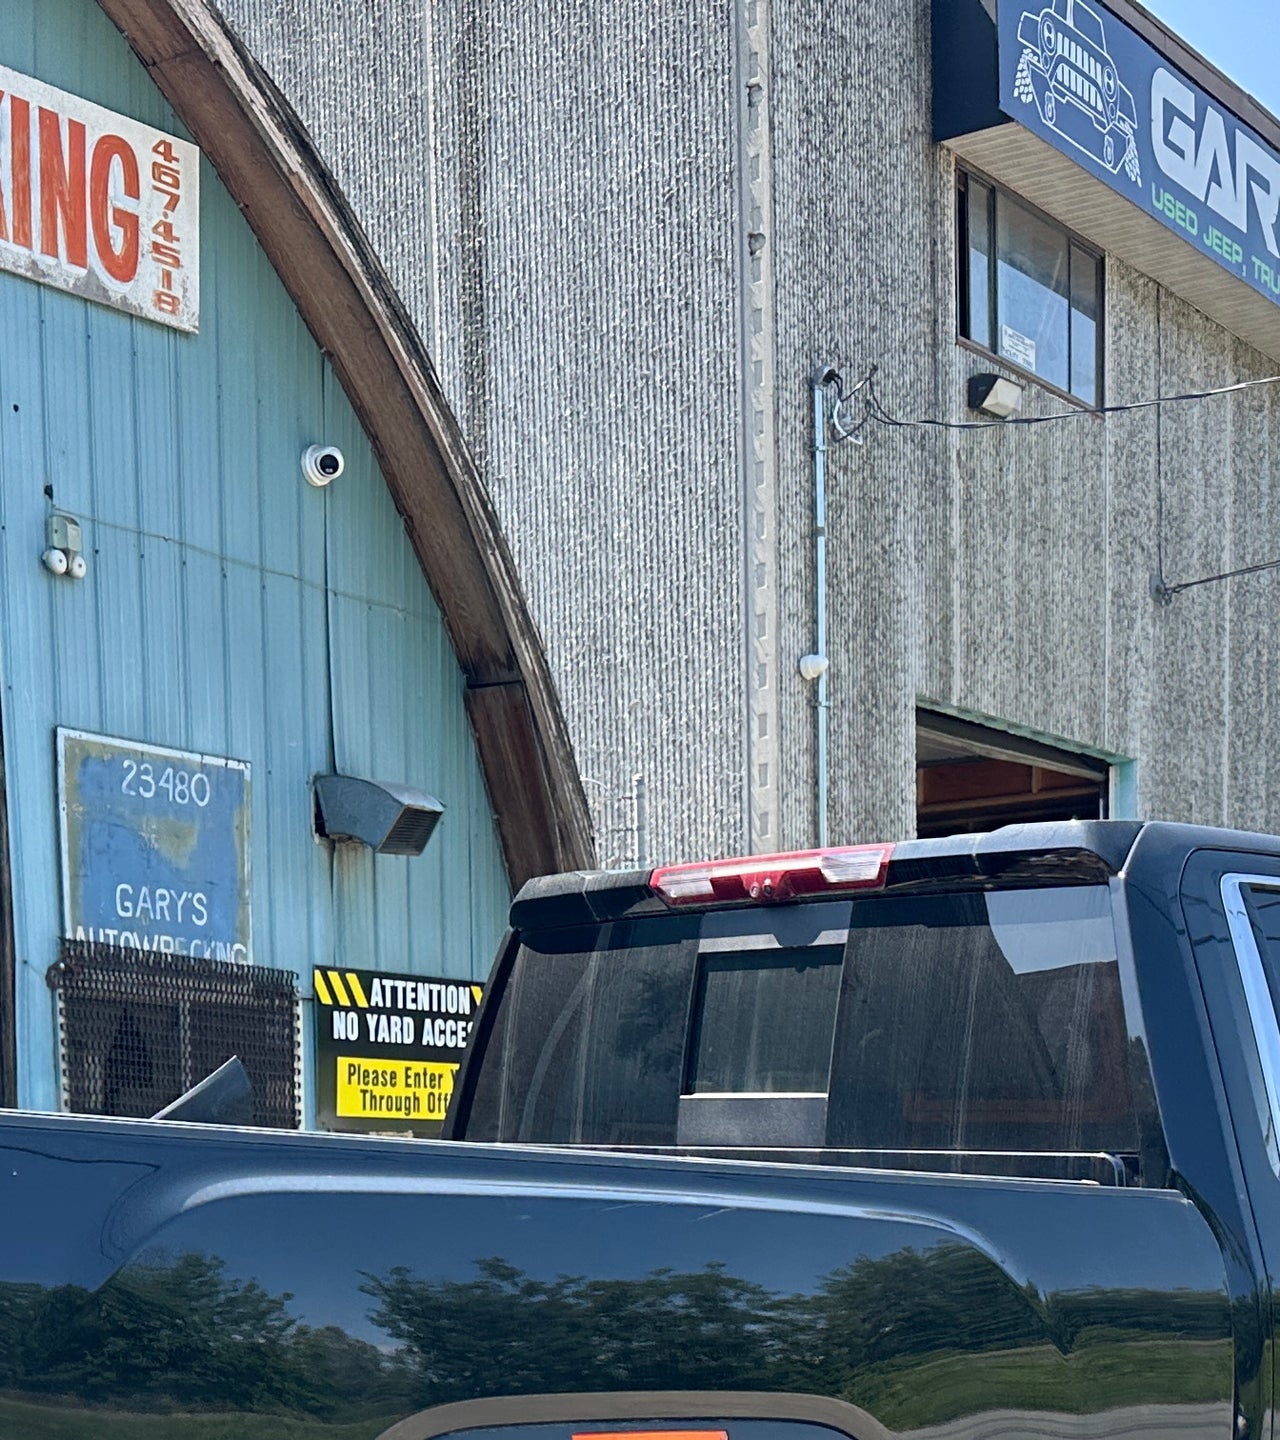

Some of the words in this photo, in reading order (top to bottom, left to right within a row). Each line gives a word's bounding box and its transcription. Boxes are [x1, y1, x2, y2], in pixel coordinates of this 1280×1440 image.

[1151, 181, 1198, 237] USED
[1203, 224, 1247, 277] JEEP,
[121, 759, 210, 807] 23480
[115, 883, 208, 927] GARY'S
[370, 977, 470, 1015] ATTENTION
[332, 1010, 359, 1041] NO
[366, 1013, 414, 1045] YARD
[348, 1063, 397, 1088] Please
[404, 1066, 443, 1090] Enter
[360, 1089, 420, 1117] Through
[428, 1091, 450, 1114] Off
